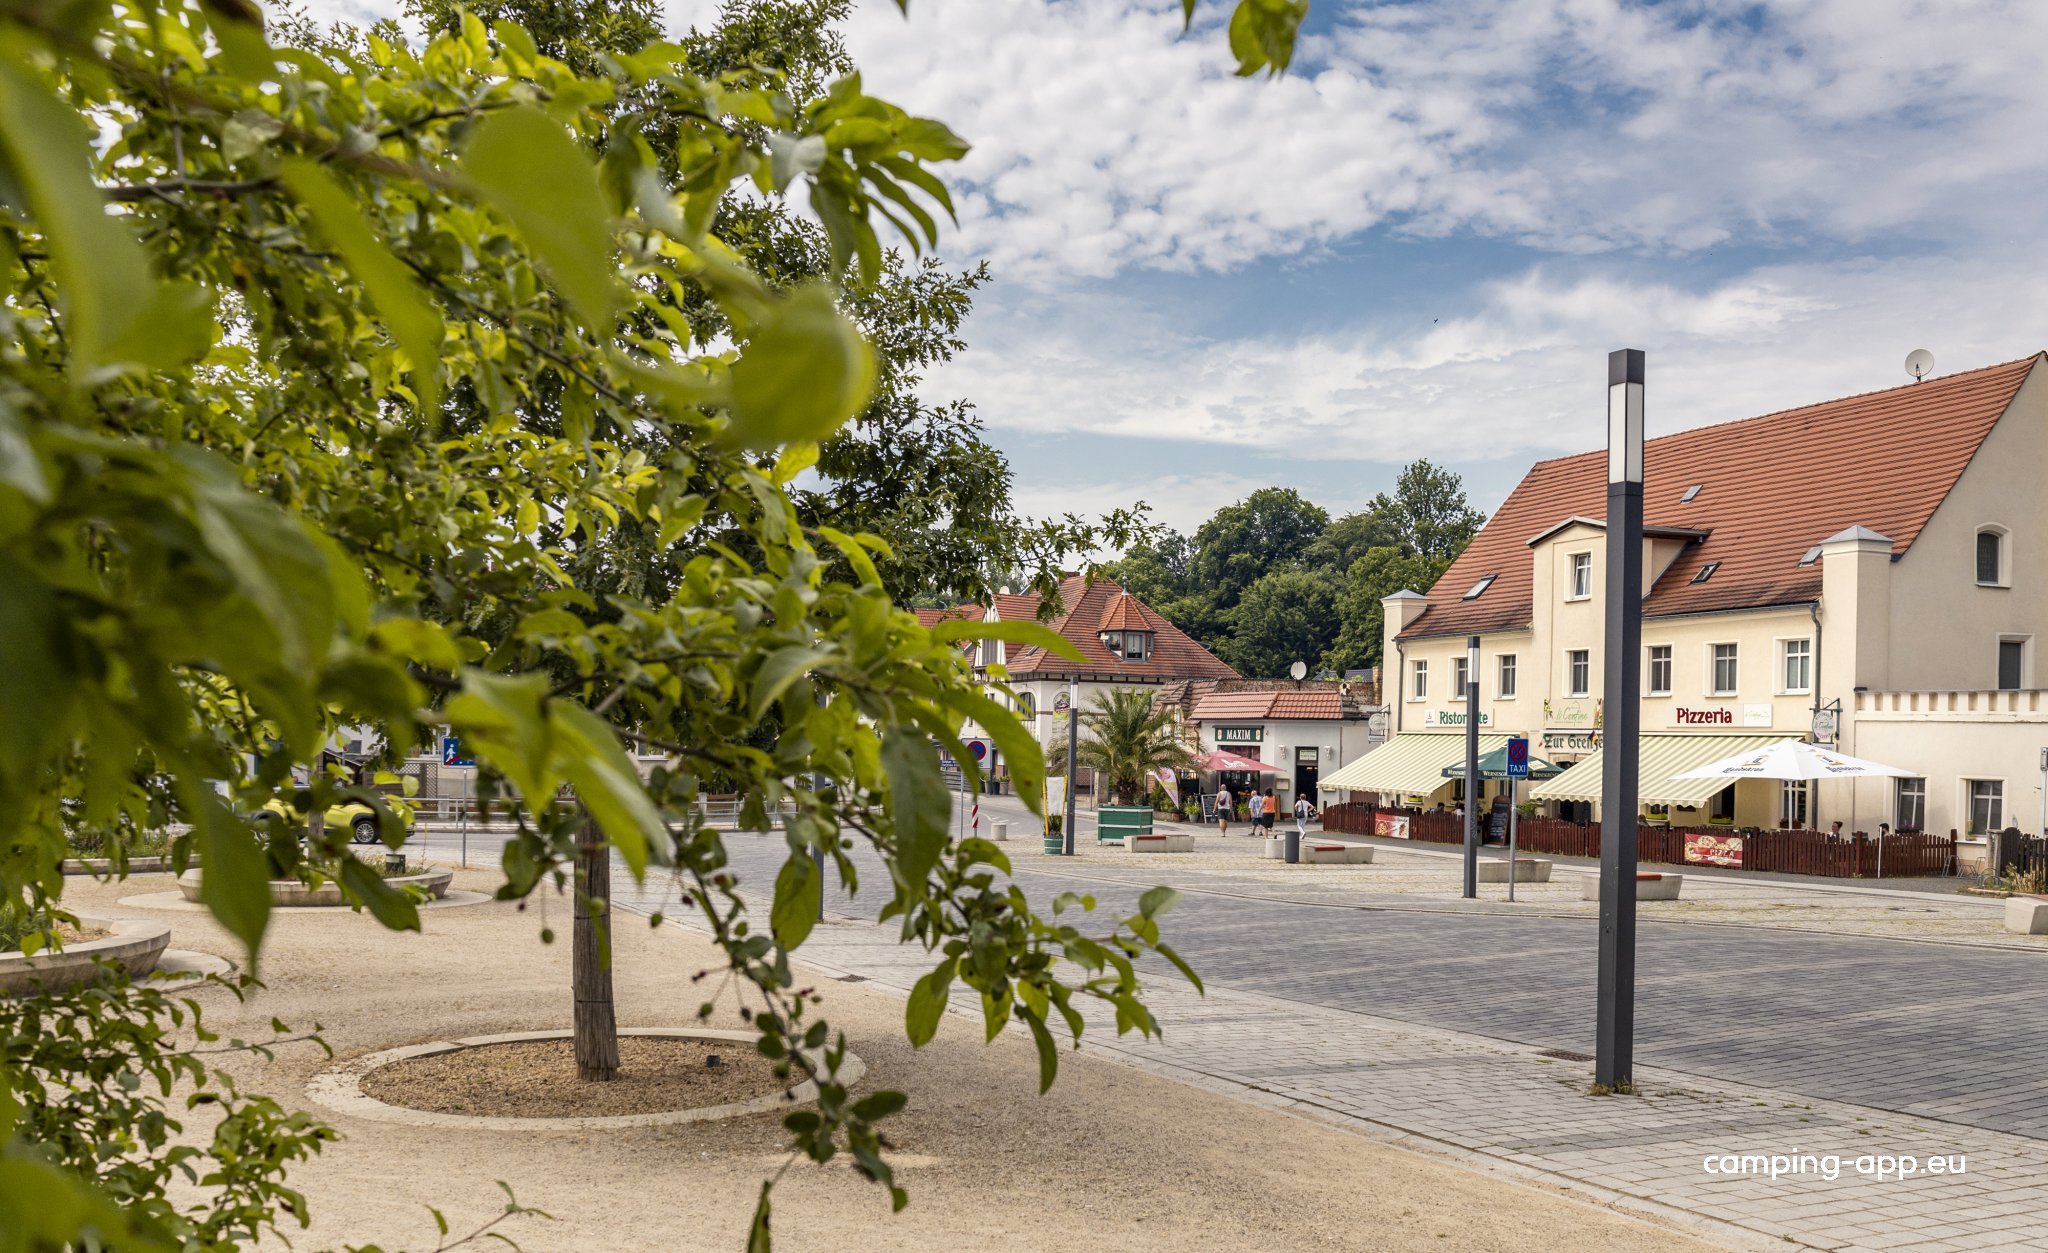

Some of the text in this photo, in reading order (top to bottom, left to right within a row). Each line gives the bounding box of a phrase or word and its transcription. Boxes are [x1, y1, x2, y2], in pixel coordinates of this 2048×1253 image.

[1439, 711, 1488, 724] Ristorte
[1676, 707, 1732, 723] Pizzeria
[1226, 729, 1251, 740] MAXIM
[1543, 734, 1564, 748] Zur
[1509, 764, 1526, 773] TAXI
[1709, 848, 1734, 858] PIZZA
